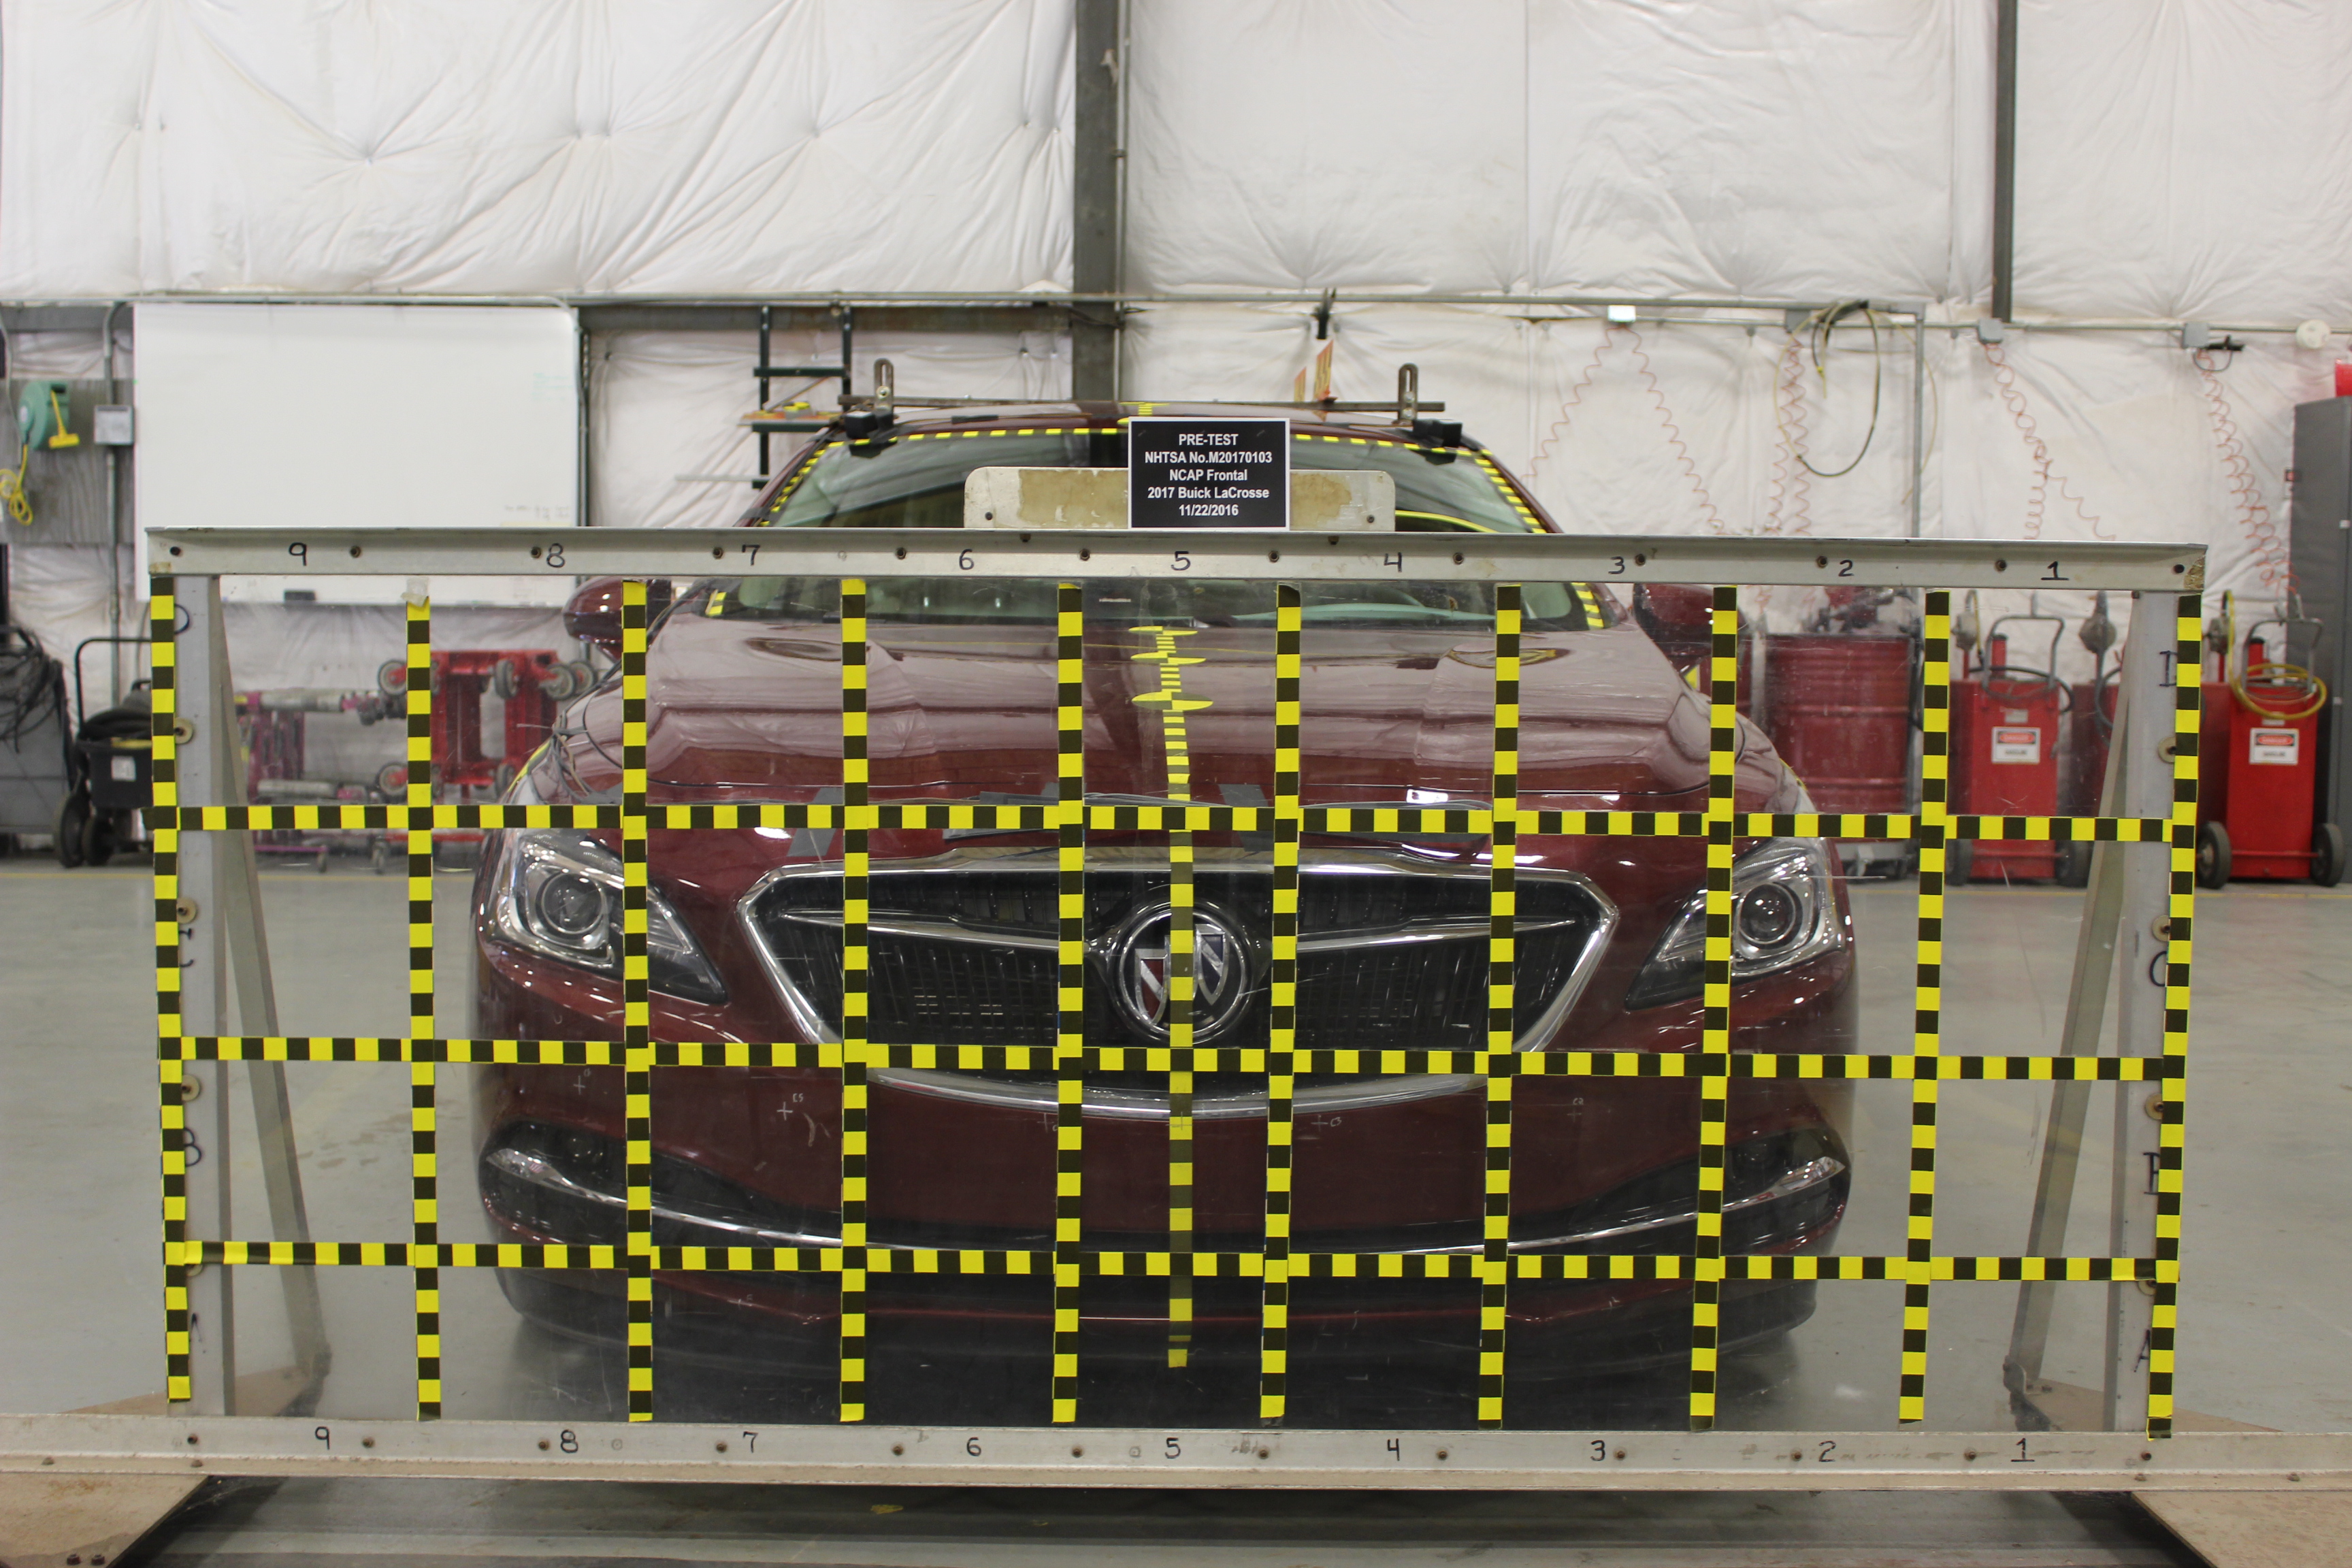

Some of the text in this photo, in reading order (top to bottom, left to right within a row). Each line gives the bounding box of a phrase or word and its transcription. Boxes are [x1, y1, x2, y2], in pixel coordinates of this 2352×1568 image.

[1179, 434, 1239, 446] PRE-TEST
[1145, 451, 1273, 463] NHTSA No.M20170103
[1169, 469, 1247, 481] NCAP Frontal
[1147, 486, 1270, 499] 2017 Buick LaCrosse
[1179, 504, 1239, 517] 11/22/2016
[289, 542, 308, 566] 9
[546, 542, 566, 568] 8
[740, 544, 761, 566] 7
[959, 549, 974, 570] 6
[1172, 550, 1191, 571] 5
[1384, 552, 1403, 573] 4
[1609, 556, 1625, 574] 3
[1838, 559, 1854, 577] 2
[2040, 561, 2069, 581] 1
[314, 1426, 330, 1450] 9
[559, 1428, 578, 1454] 8
[742, 1431, 758, 1454] 7
[966, 1437, 982, 1457] 6
[1164, 1437, 1181, 1459] 5
[1386, 1438, 1400, 1462] 4
[1590, 1439, 1606, 1462] 3
[1818, 1440, 1836, 1463] 2
[2010, 1437, 2036, 1463] 1
